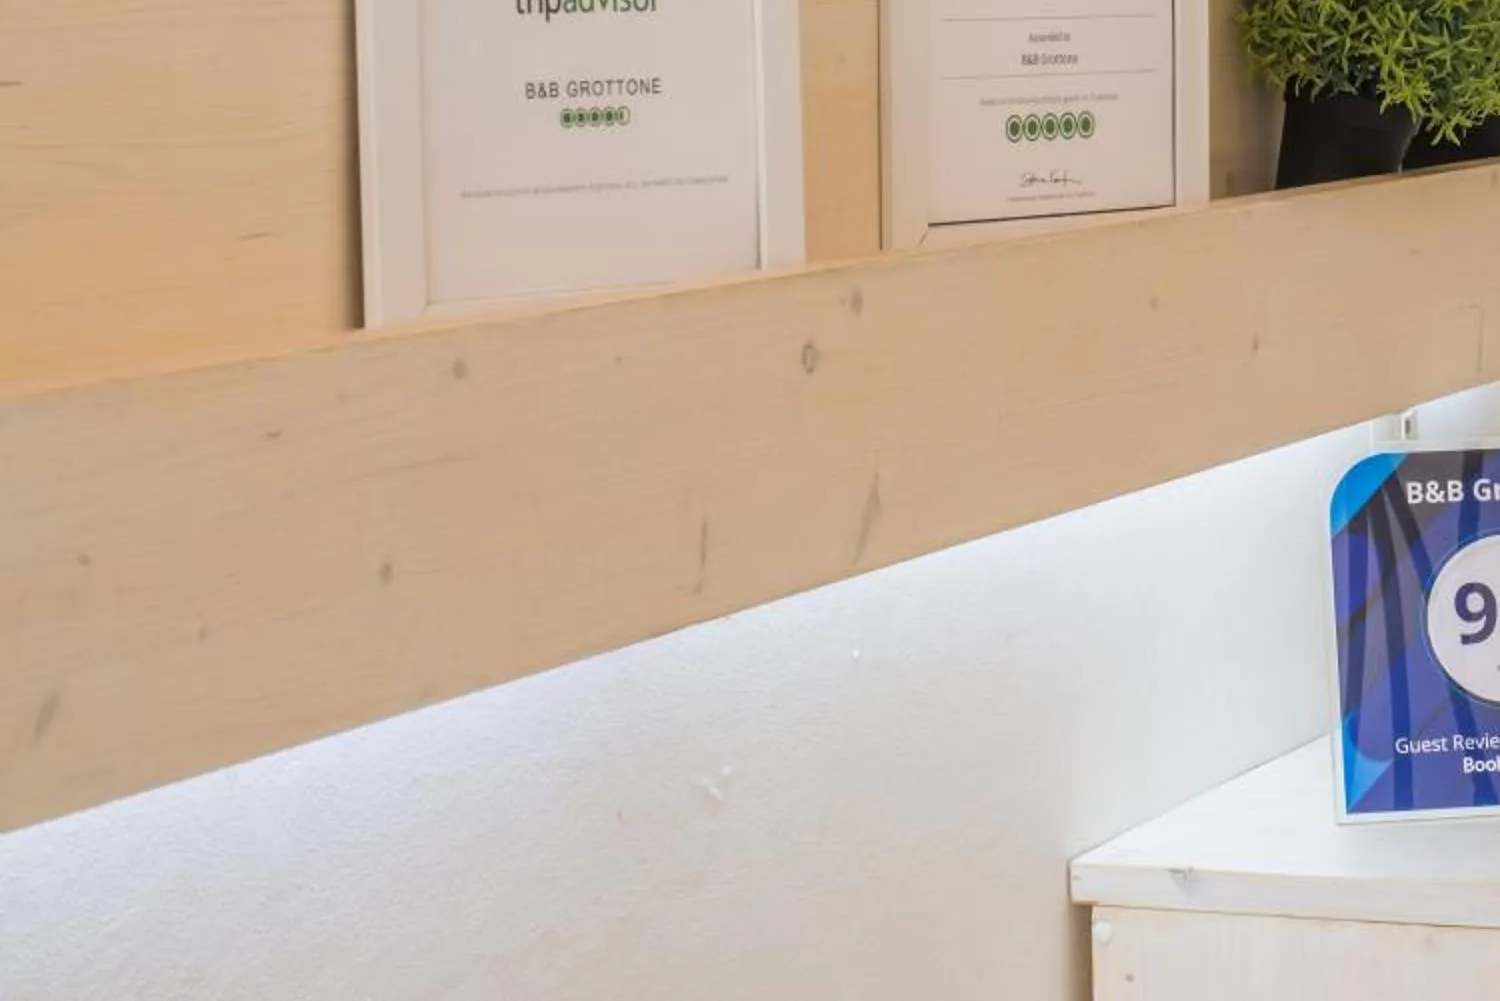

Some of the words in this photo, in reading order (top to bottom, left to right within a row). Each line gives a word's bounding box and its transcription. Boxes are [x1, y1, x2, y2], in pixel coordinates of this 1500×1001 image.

[525, 82, 559, 99] B&B
[567, 77, 663, 98] GROTTONE
[1406, 479, 1464, 504] B&B
[1395, 736, 1449, 754] Guest
